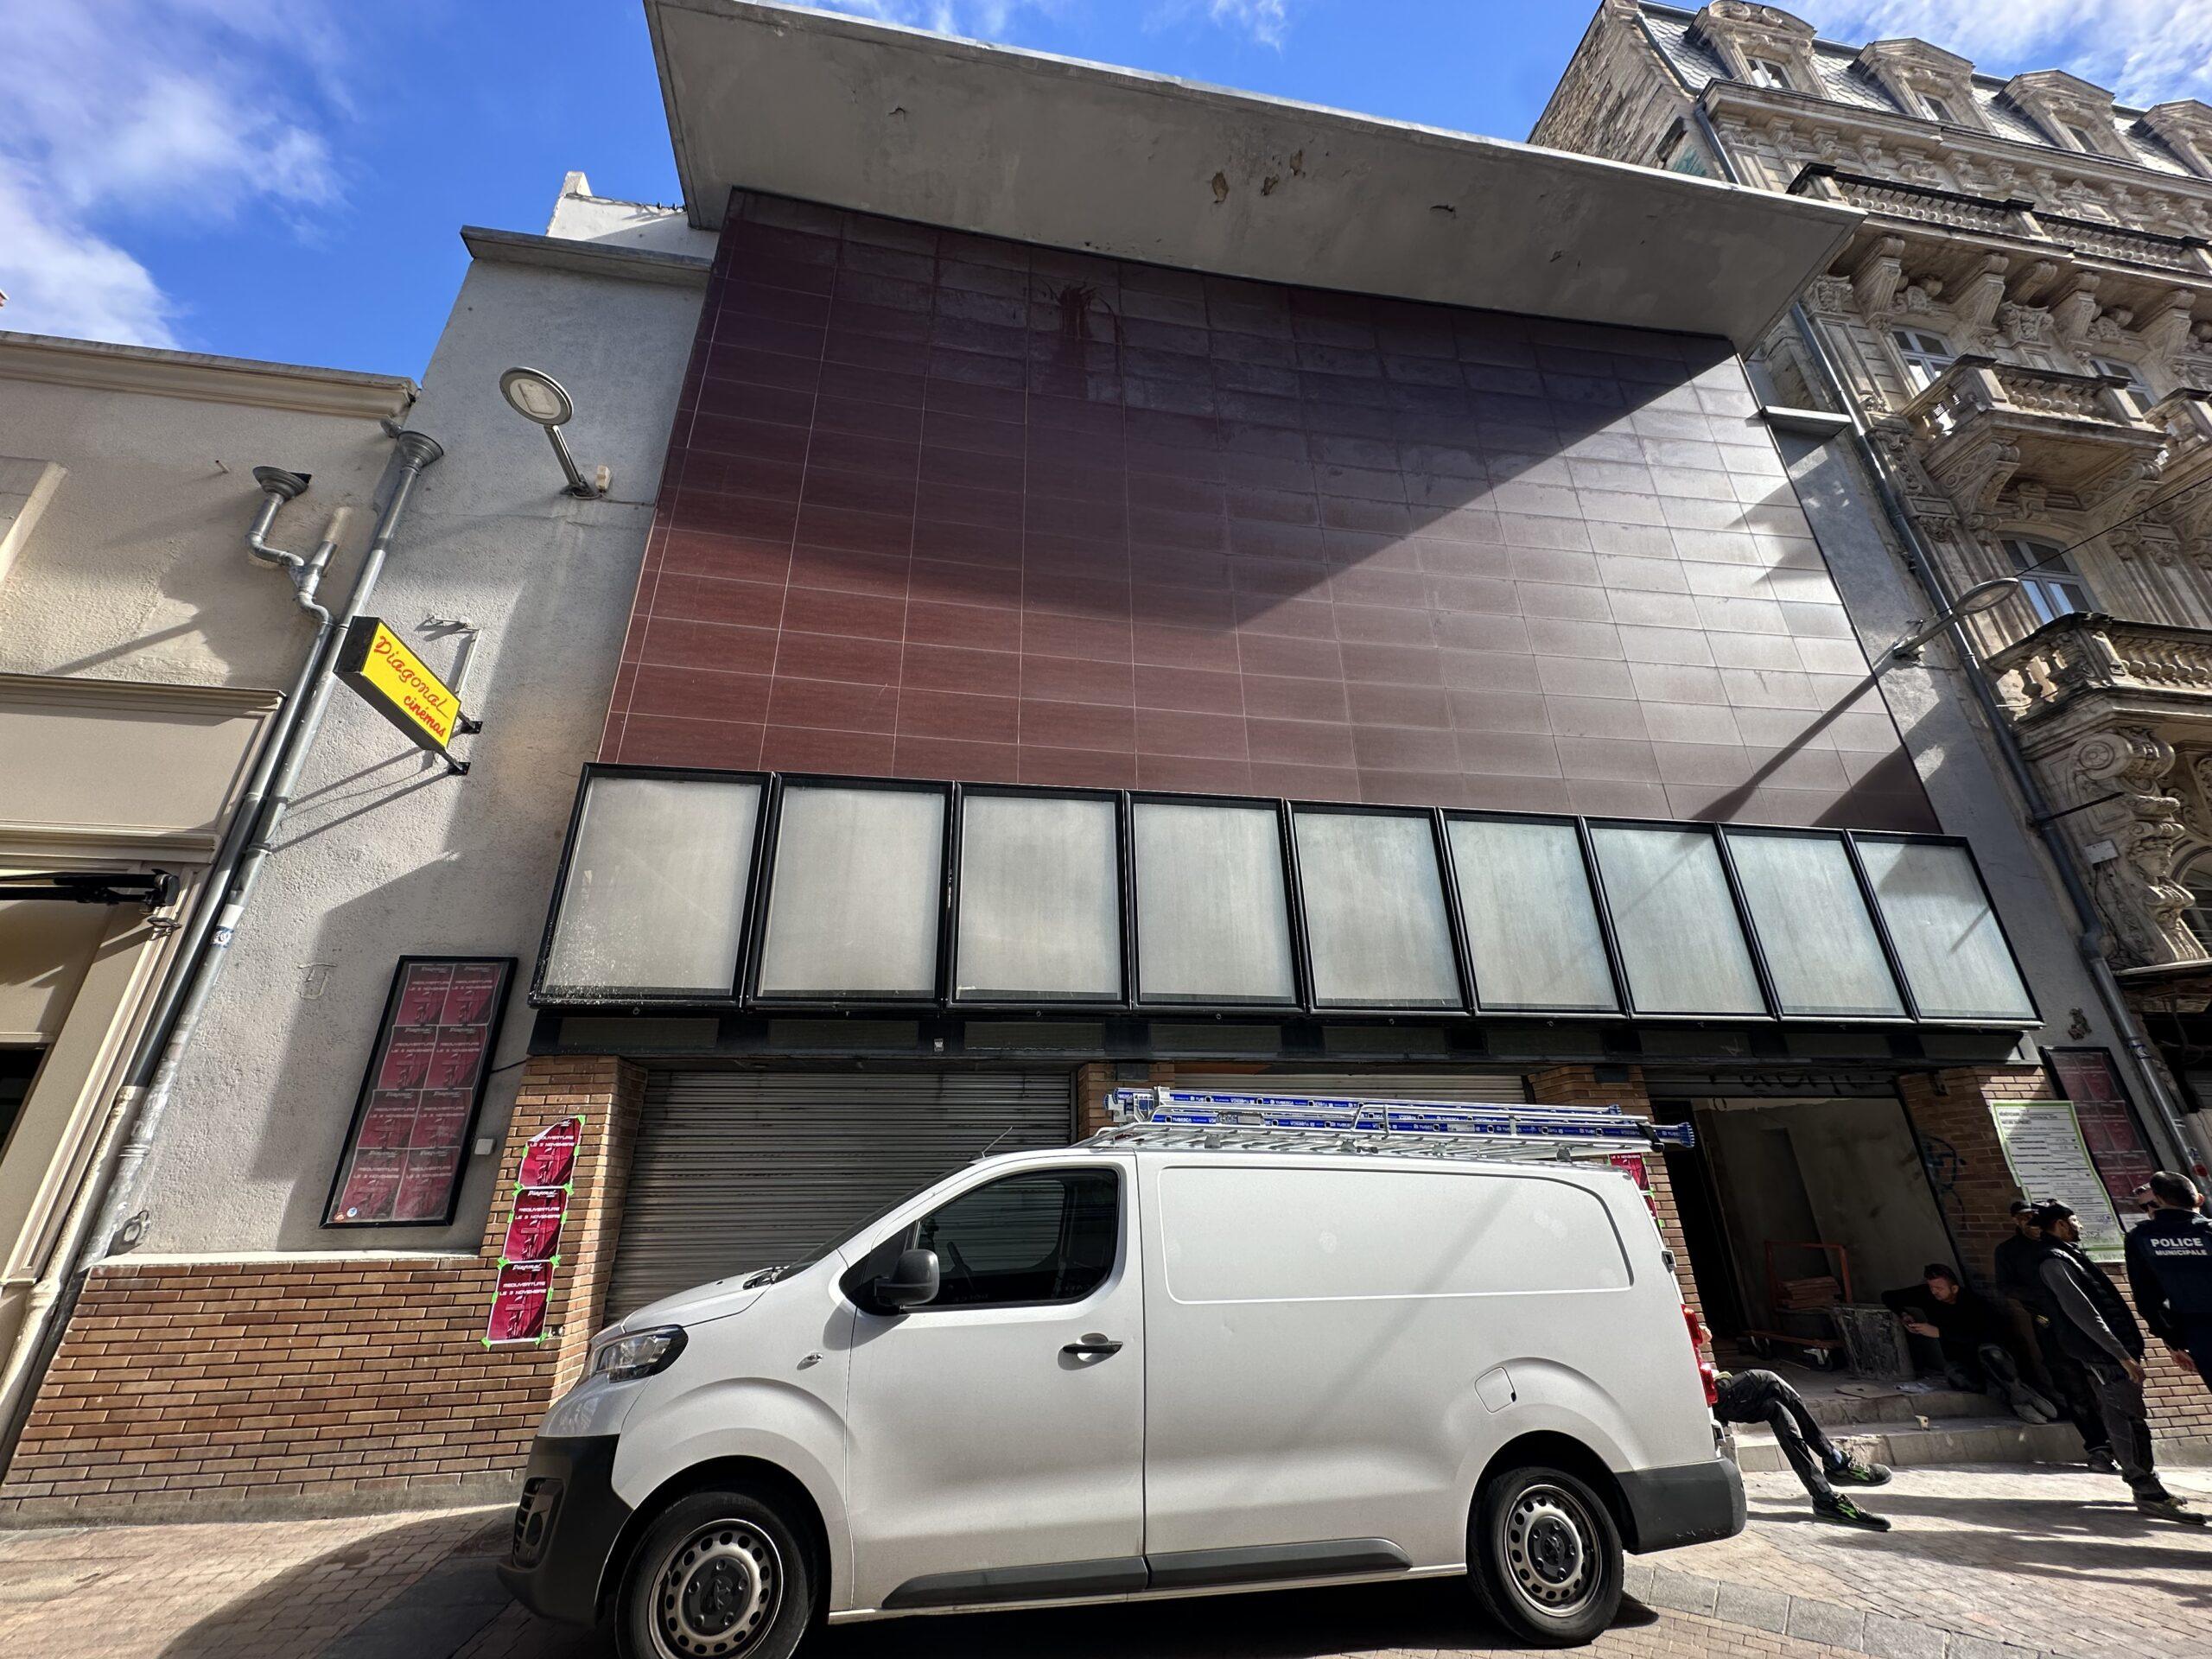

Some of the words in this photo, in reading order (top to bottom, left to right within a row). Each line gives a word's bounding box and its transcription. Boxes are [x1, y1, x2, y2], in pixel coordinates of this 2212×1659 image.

[373, 635, 449, 719] Diagonal
[404, 695, 446, 737] cinémas
[2150, 1237, 2203, 1248] POLICE
